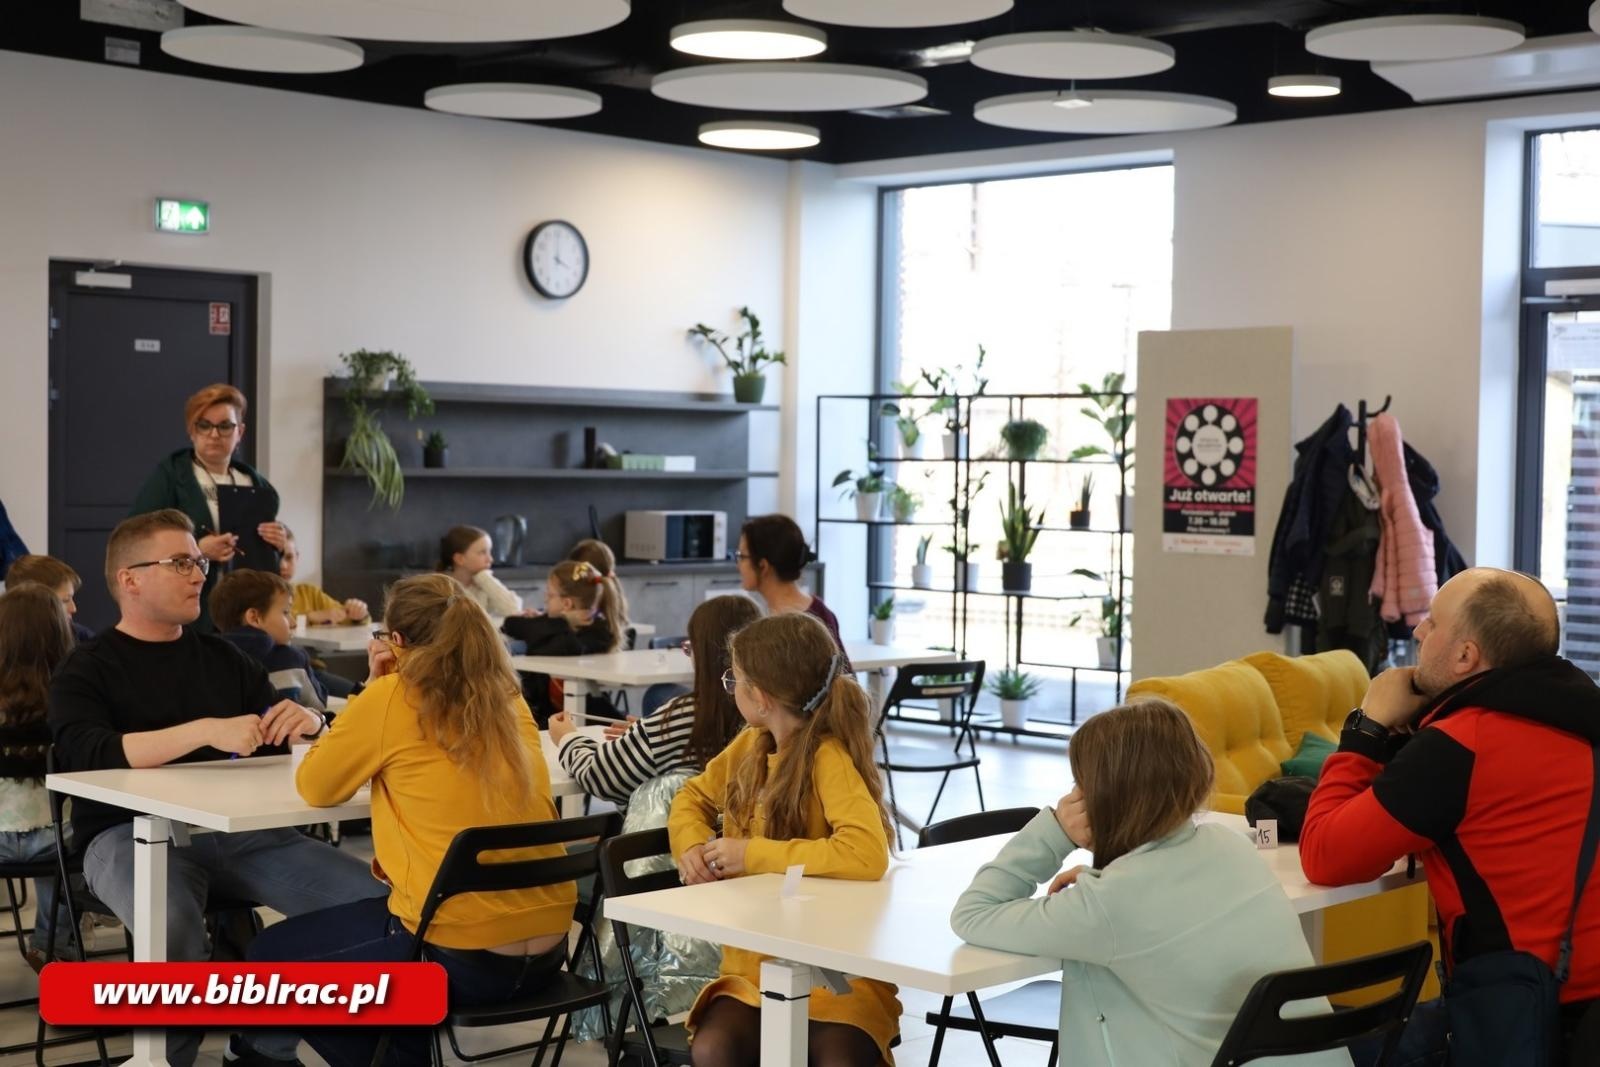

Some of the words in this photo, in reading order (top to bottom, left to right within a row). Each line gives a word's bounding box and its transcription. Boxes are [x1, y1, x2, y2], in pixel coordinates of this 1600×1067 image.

[1169, 488, 1193, 501] Już
[1194, 489, 1251, 503] otwarte!
[1258, 829, 1271, 844] 15
